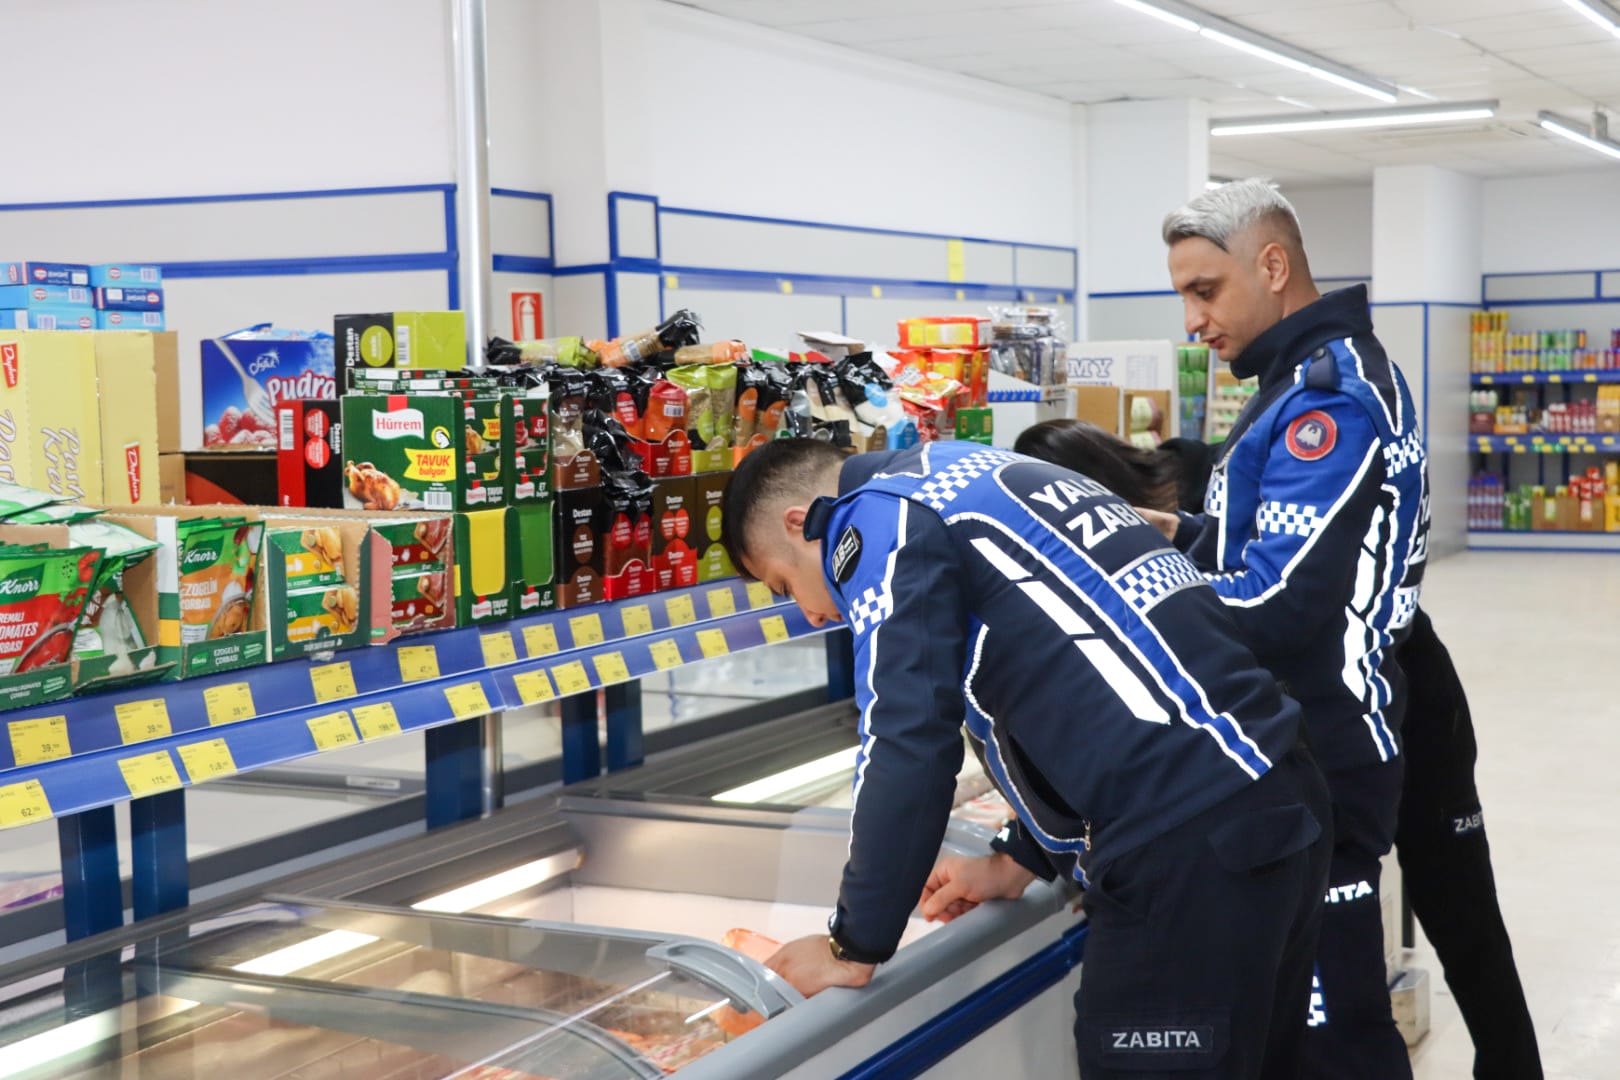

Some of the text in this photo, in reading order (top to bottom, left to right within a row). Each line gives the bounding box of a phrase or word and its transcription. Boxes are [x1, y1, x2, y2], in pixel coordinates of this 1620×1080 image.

[267, 370, 336, 407] Pudra
[375, 417, 423, 431] Hürrem
[58, 428, 86, 502] Past
[416, 454, 452, 467] TAVUK
[419, 467, 447, 479] bulyon
[1065, 503, 1151, 550] ZABI
[184, 548, 218, 564] Knorr
[0, 578, 39, 595] Knorr
[1112, 1030, 1201, 1048] ZABITA
